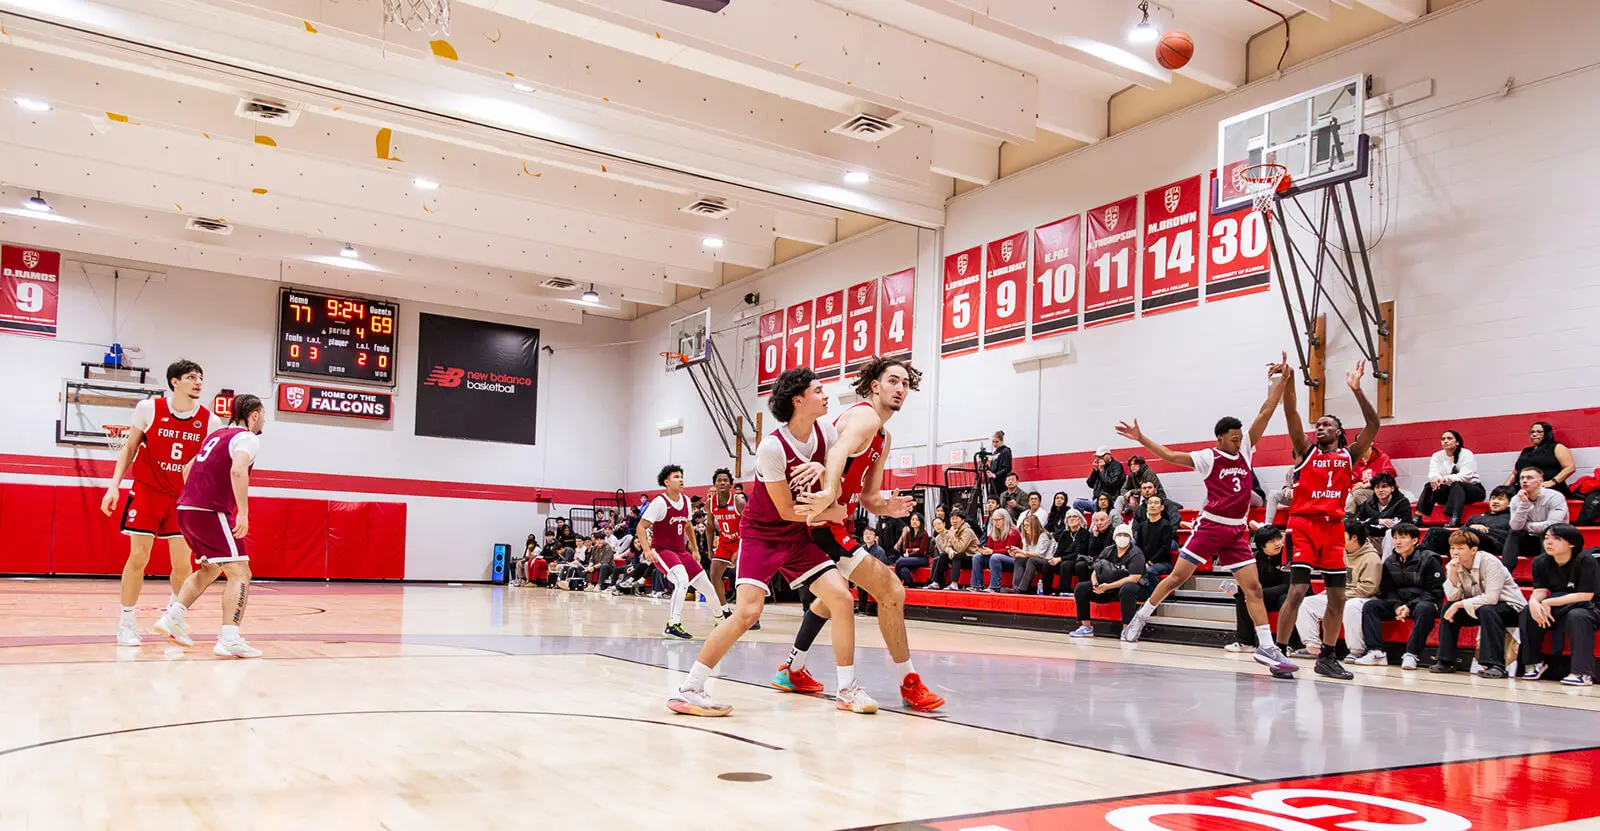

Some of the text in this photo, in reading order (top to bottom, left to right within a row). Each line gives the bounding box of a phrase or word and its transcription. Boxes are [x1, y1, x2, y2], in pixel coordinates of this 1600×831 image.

[1148, 212, 1196, 234] M.BROWN
[1212, 212, 1268, 264] 30
[1148, 230, 1194, 280] 14
[3, 268, 56, 282] D.RAMOS
[1094, 247, 1128, 293] 11
[1038, 264, 1076, 307] 10
[16, 282, 44, 312] 9
[290, 294, 308, 304] Home
[996, 280, 1016, 318] 9
[290, 304, 312, 323] 77
[328, 300, 364, 319] 9:24
[370, 306, 392, 316] Guests
[953, 292, 970, 329] 5
[328, 326, 364, 338] period 4
[372, 316, 392, 334] 69
[888, 310, 904, 342] 4
[286, 332, 302, 342] fouls
[328, 338, 348, 348] player
[822, 328, 835, 360] 2
[854, 320, 868, 352] 3
[290, 344, 318, 359] 0 3
[374, 344, 390, 353] fouls
[794, 336, 804, 366] 1
[286, 360, 300, 368] won
[358, 352, 387, 368] 2 0
[765, 344, 777, 373] 0
[374, 370, 388, 378] won
[468, 371, 532, 386] new balance
[466, 380, 515, 394] basketball
[321, 390, 345, 399] HOME
[360, 394, 376, 402] THE
[312, 398, 384, 414] FALCONS
[158, 428, 200, 442] FORT ERIE
[171, 442, 184, 460] 6
[196, 436, 220, 462] 9
[158, 461, 186, 472] CADE
[1312, 459, 1330, 468] FORT
[1218, 467, 1248, 480] Cougars
[1327, 471, 1333, 488] 1
[1232, 477, 1242, 493] 3
[1312, 489, 1341, 499] ACADEM
[678, 524, 682, 535] 8
[722, 522, 730, 532] 0
